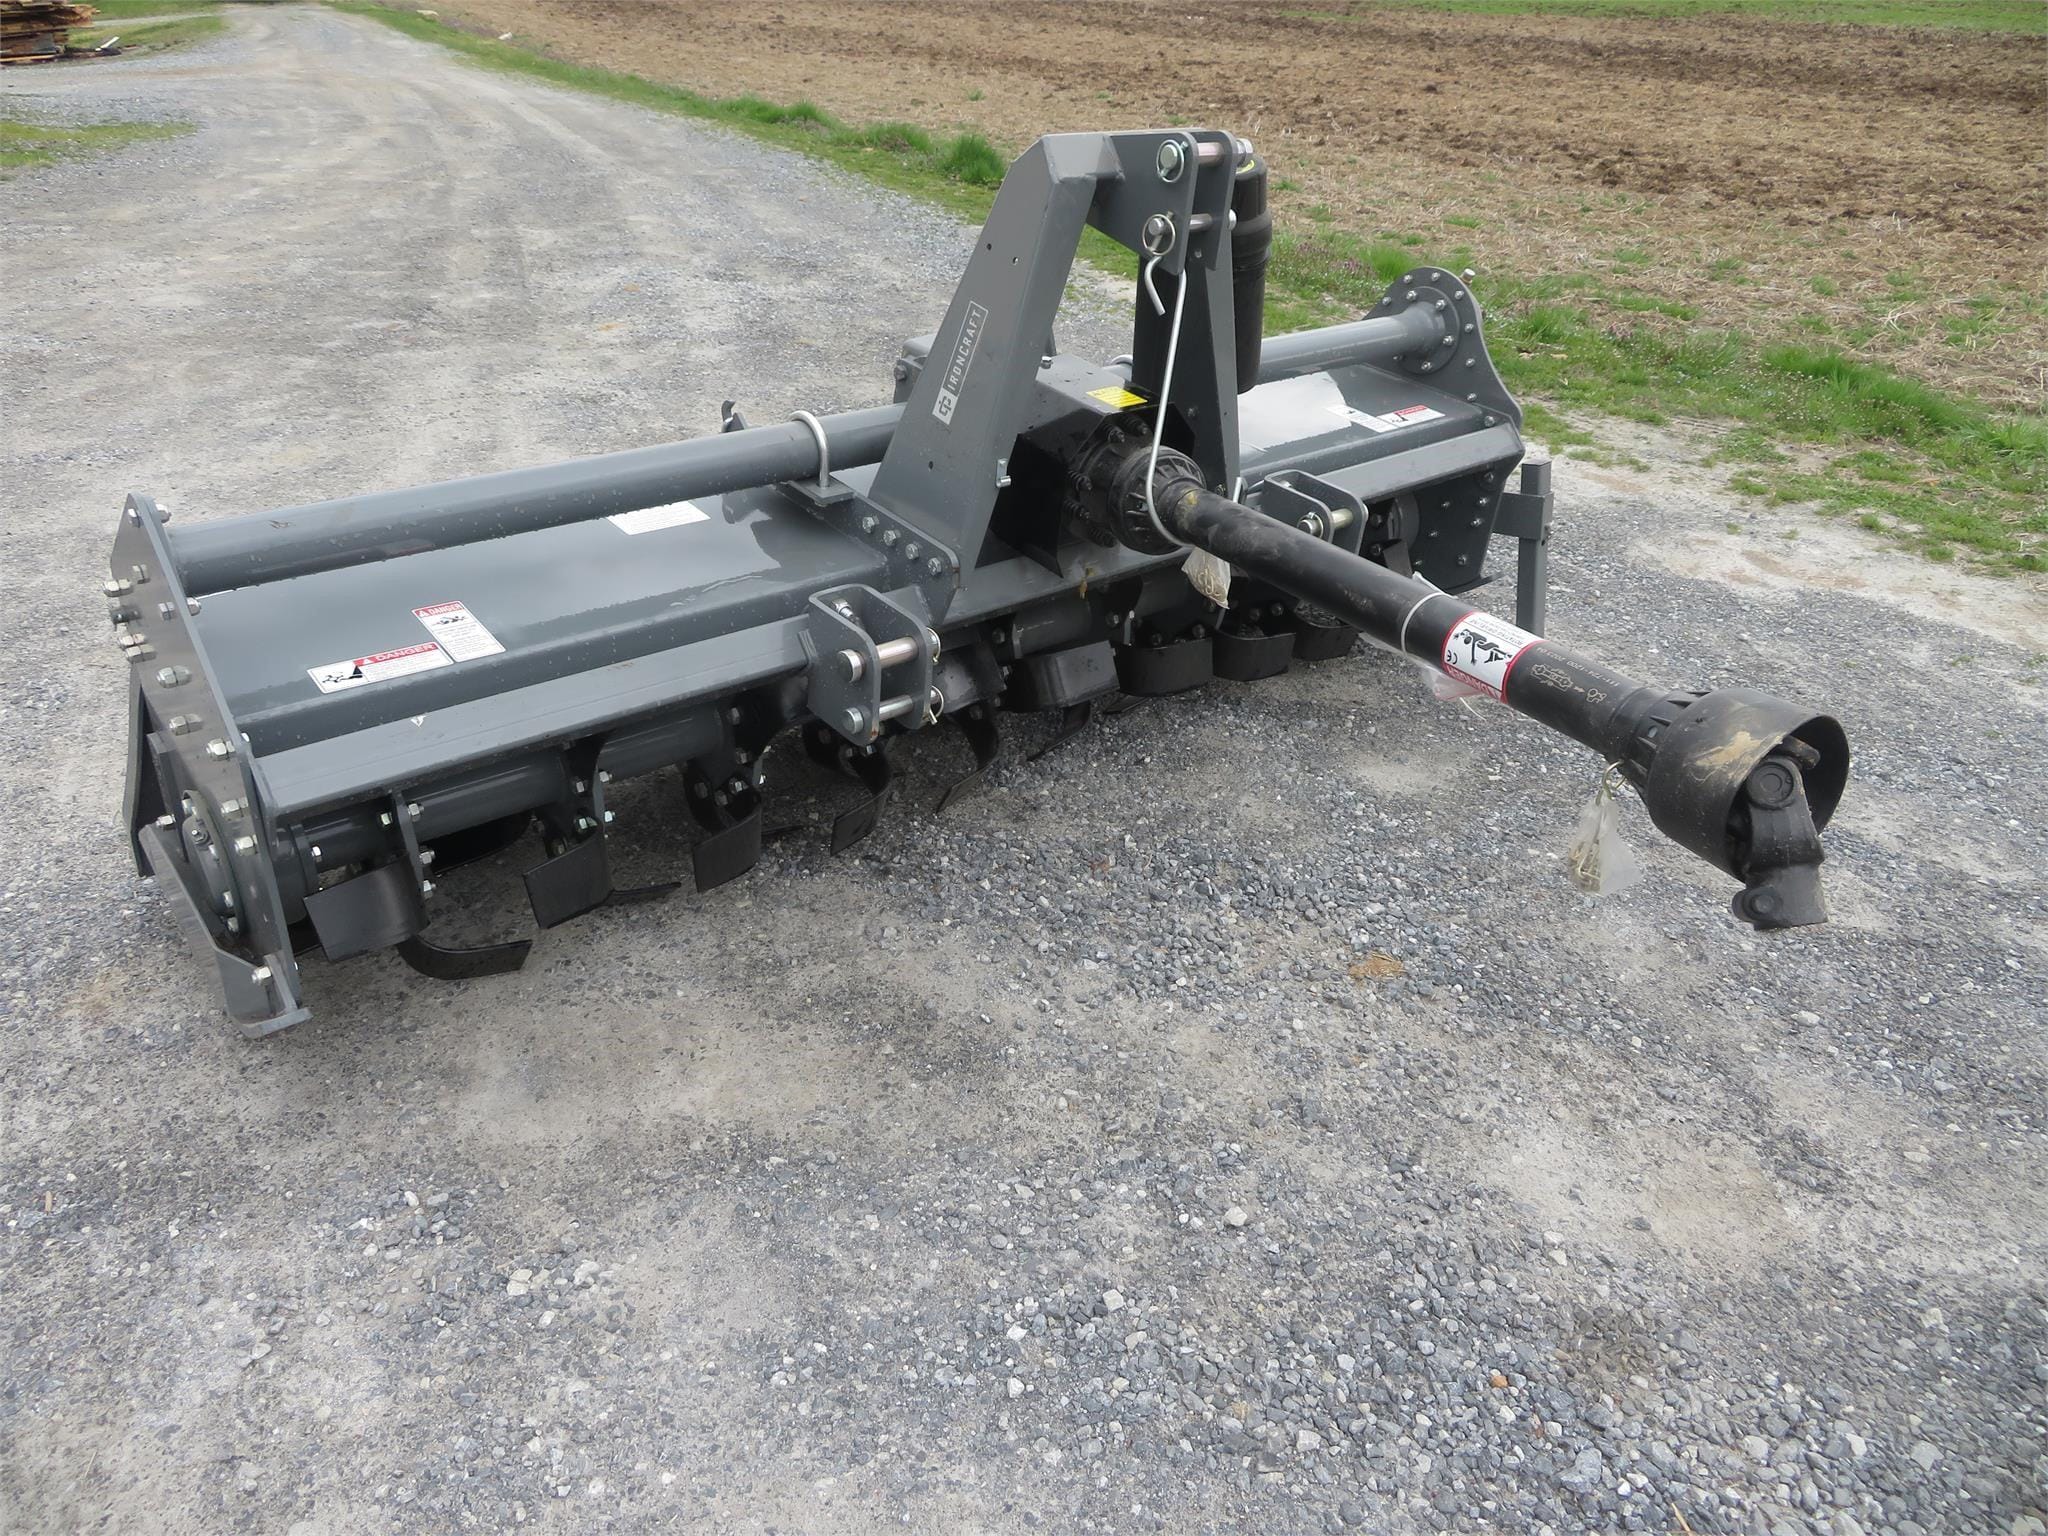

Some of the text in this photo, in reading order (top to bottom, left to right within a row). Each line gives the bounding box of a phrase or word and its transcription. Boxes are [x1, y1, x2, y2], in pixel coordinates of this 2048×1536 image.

[947, 309, 981, 391] IRONCRAFT
[429, 603, 463, 616] DANGER
[375, 643, 438, 661] DANGER
[1447, 649, 1458, 665] CE
